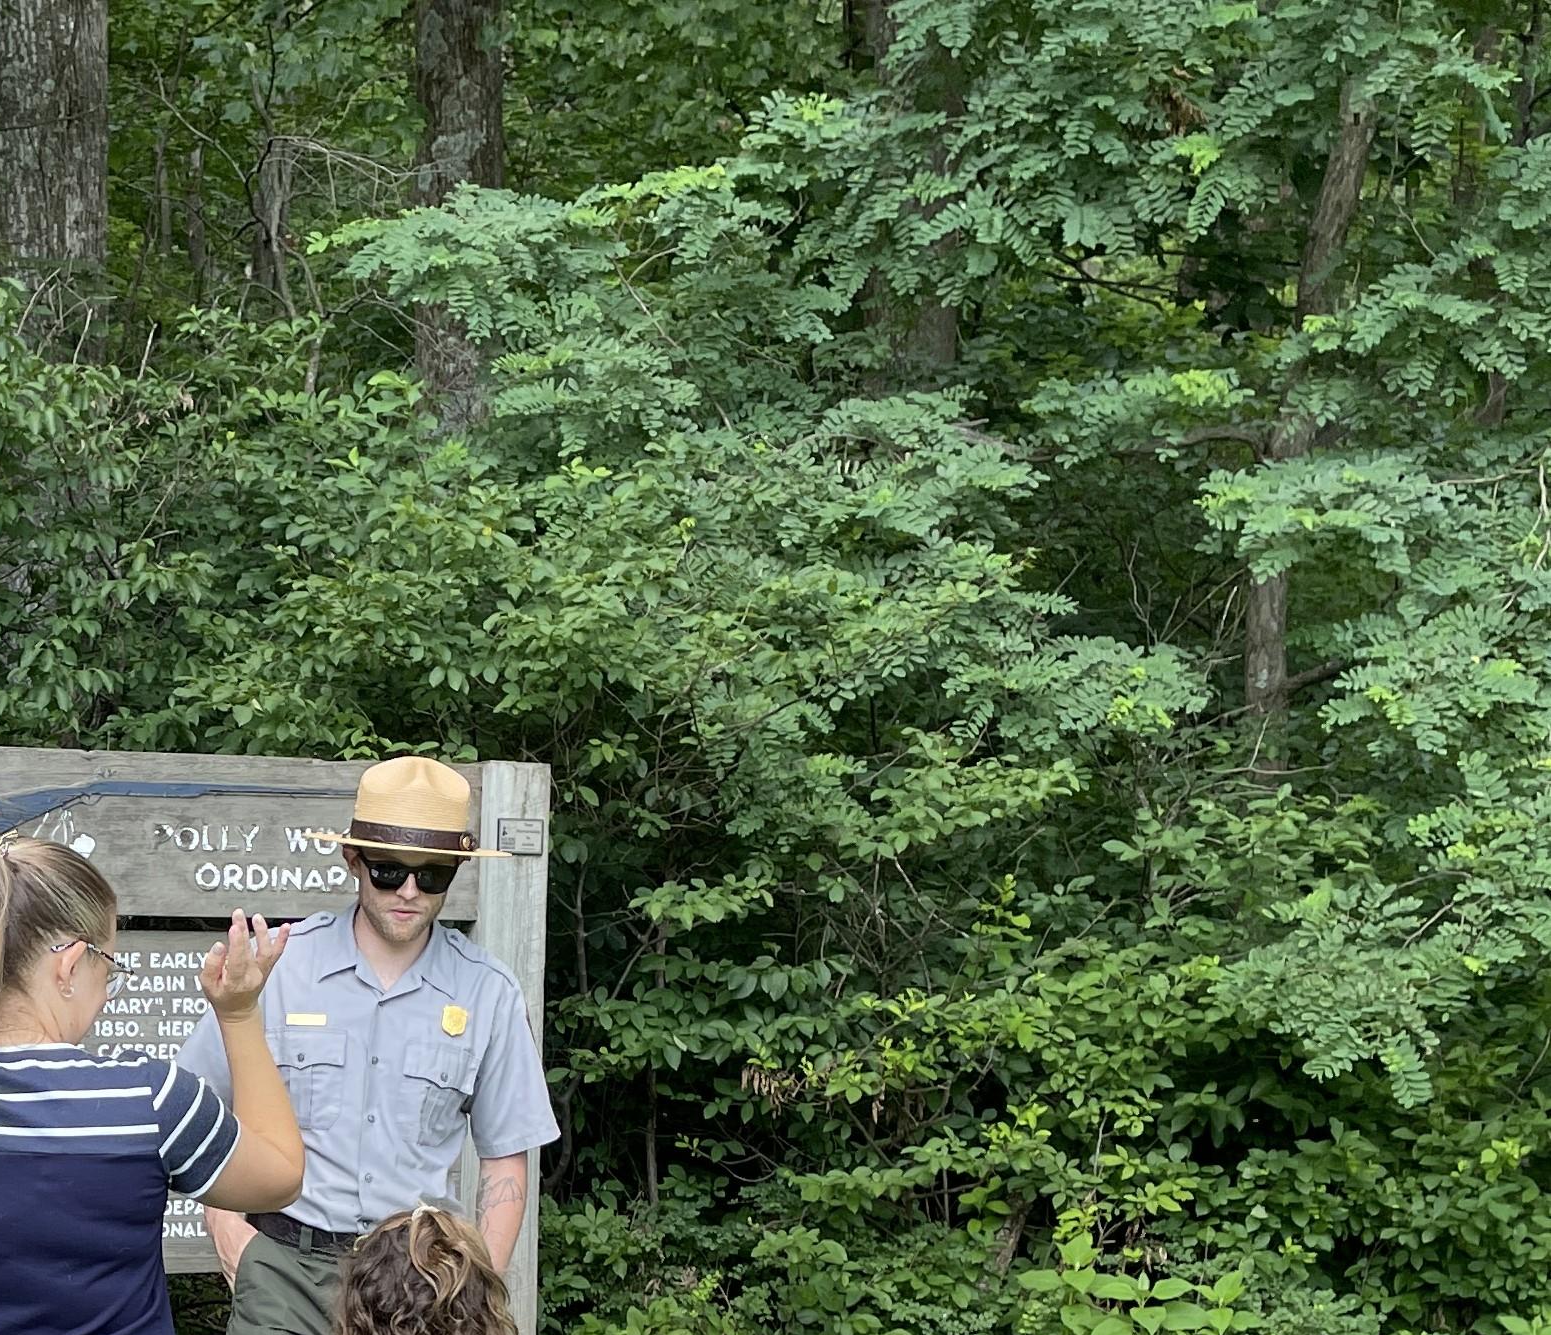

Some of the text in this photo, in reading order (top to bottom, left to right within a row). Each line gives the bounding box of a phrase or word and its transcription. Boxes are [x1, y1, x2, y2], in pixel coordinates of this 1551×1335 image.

[153, 823, 260, 852] POLLY
[284, 827, 351, 855] WO
[126, 975, 185, 992] CABIN
[172, 998, 212, 1014] FRO
[94, 1020, 145, 1037] 1850.
